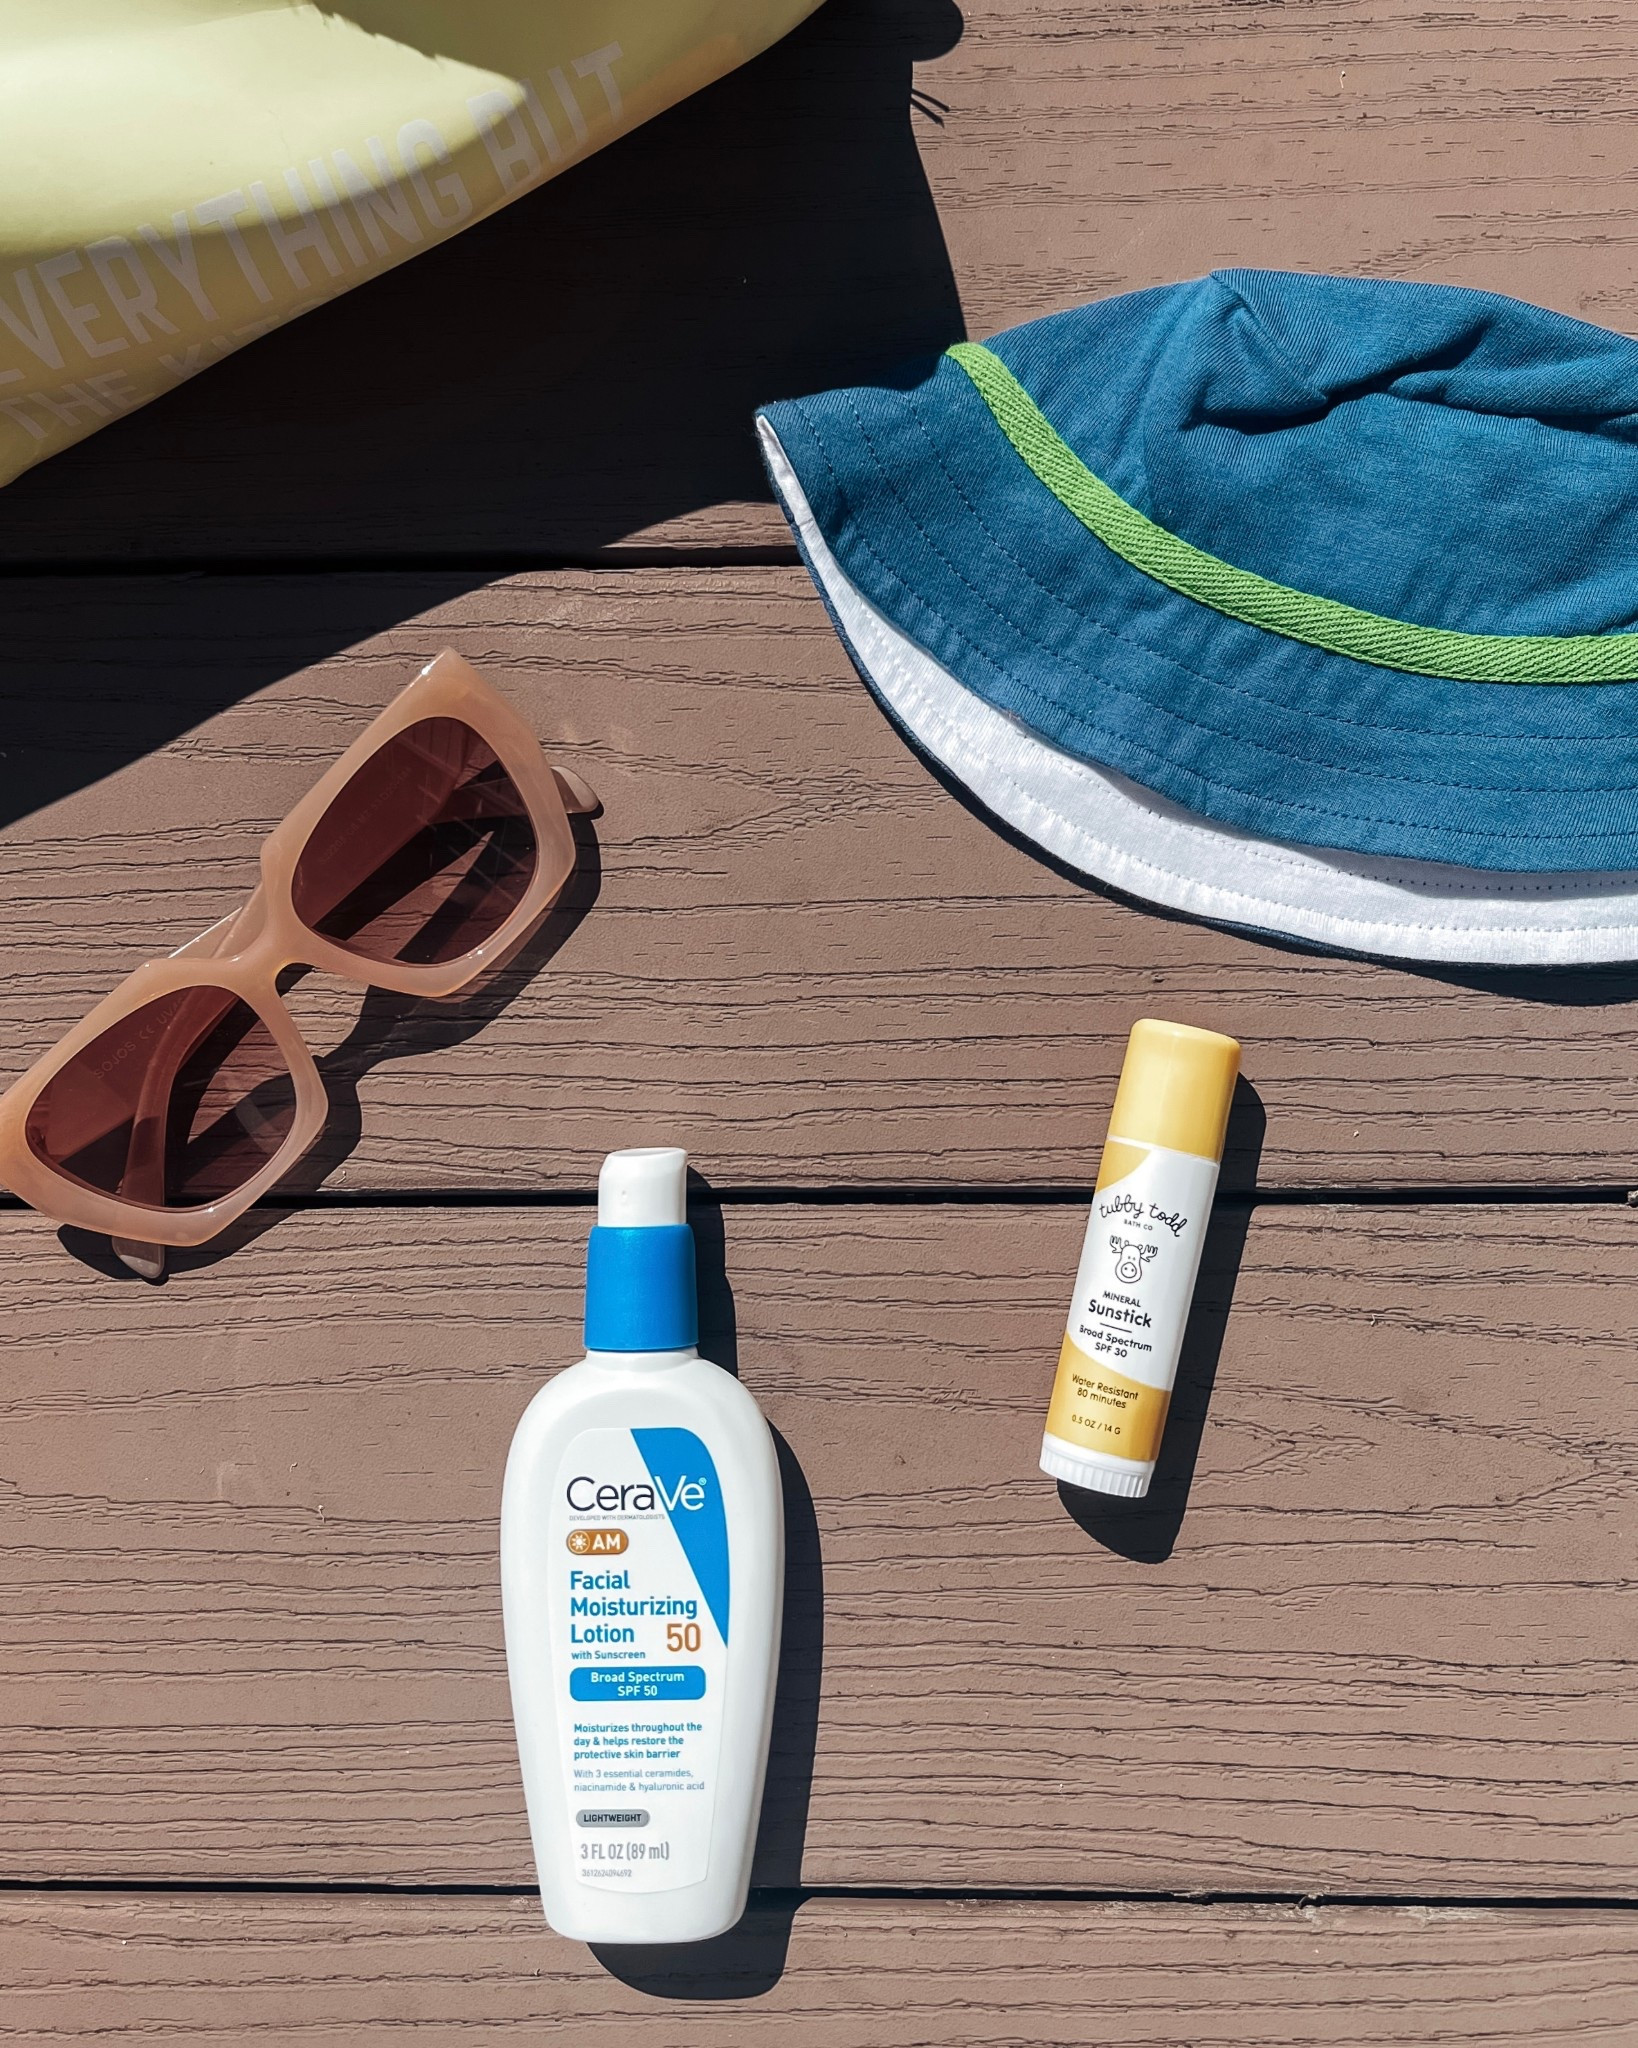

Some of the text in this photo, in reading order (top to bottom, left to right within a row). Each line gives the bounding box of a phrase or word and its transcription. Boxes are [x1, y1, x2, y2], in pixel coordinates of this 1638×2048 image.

[0, 118, 473, 385] VERYTHING
[467, 41, 624, 197] BUT
[93, 1040, 136, 1080] SOJOS
[1099, 1194, 1188, 1238] tubby todd
[1123, 1218, 1154, 1232] BATH CO
[1102, 1290, 1142, 1308] MINERAL
[1088, 1299, 1153, 1329] Sunstick
[1079, 1324, 1153, 1353] Broad Spectrum
[1094, 1341, 1128, 1359] SPF 30
[1072, 1373, 1139, 1401] Water Resistant
[1077, 1387, 1127, 1409] 80 minutes
[1071, 1414, 1121, 1436] 0.5 OZ / 14 G
[617, 1513, 666, 1521] DERMATOLOGISTS
[592, 1533, 621, 1551] AM
[570, 1570, 631, 1590] Facial
[570, 1595, 698, 1620] Moisturizing
[570, 1624, 635, 1644] Lotion
[666, 1622, 702, 1653] 50
[571, 1650, 646, 1660] with Sunscreen
[590, 1671, 685, 1686] Broad Spectrum
[617, 1686, 658, 1697] SPF 50
[573, 1721, 703, 1735] Moisturizes throughout the
[573, 1735, 685, 1748] day & helps restore the
[573, 1748, 681, 1761] protective skin barrier
[573, 1768, 694, 1778] With 3 essential ceramides,
[574, 1781, 705, 1793] niacinamide & hyaluronic acid
[583, 1813, 643, 1823] LIGHTWEIGHT
[580, 1841, 671, 1861] 3 FL OZ (89 ml)
